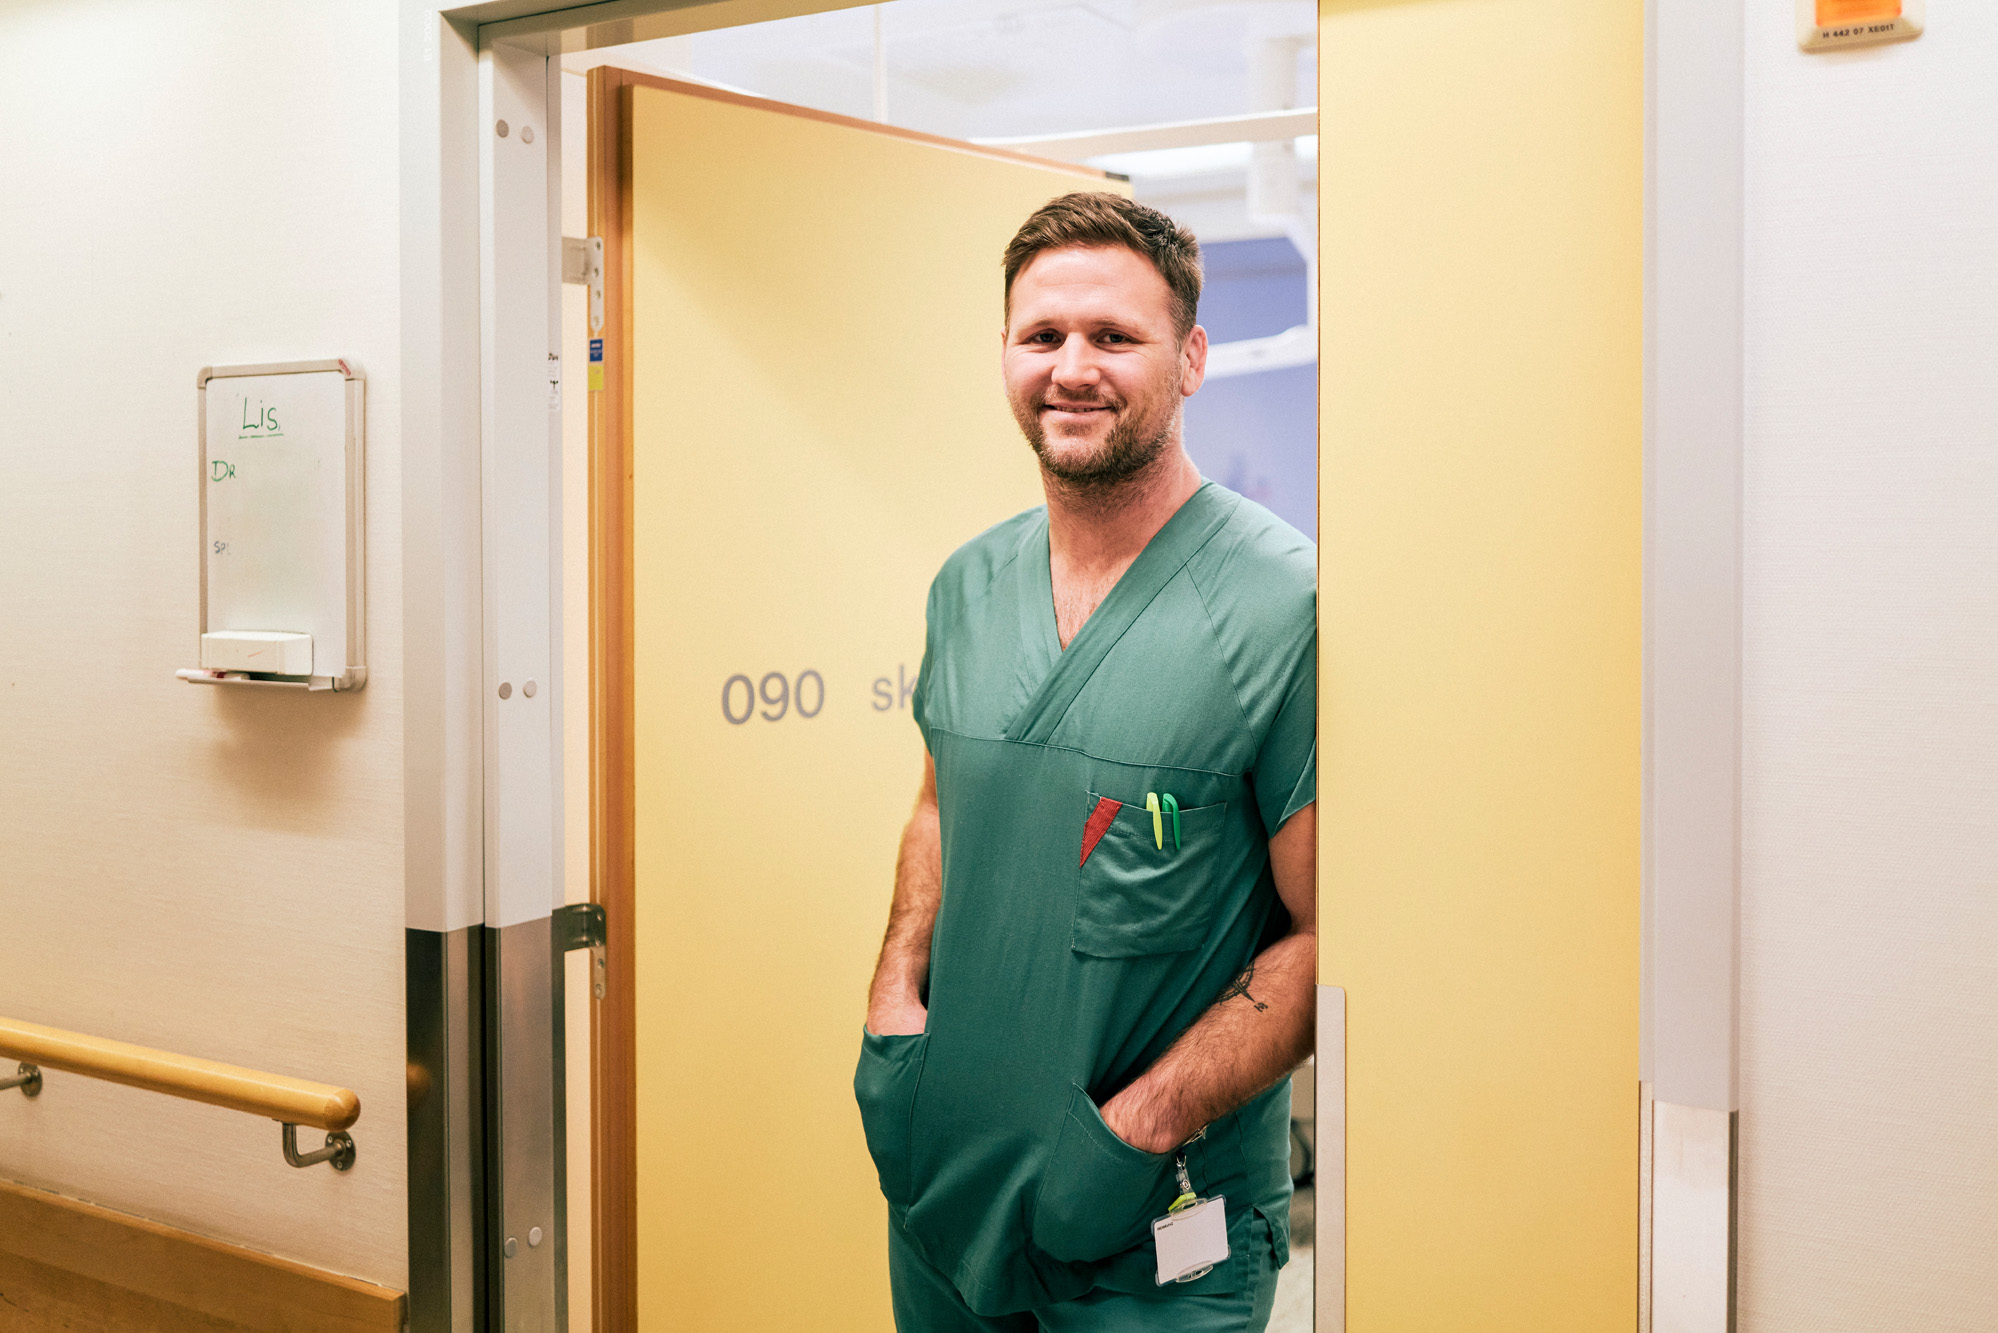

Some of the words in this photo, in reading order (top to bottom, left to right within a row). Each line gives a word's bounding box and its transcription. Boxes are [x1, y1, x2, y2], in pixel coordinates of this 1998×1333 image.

[1833, 29, 1849, 37] 442
[1853, 27, 1864, 35] 07
[722, 669, 824, 725] 090
